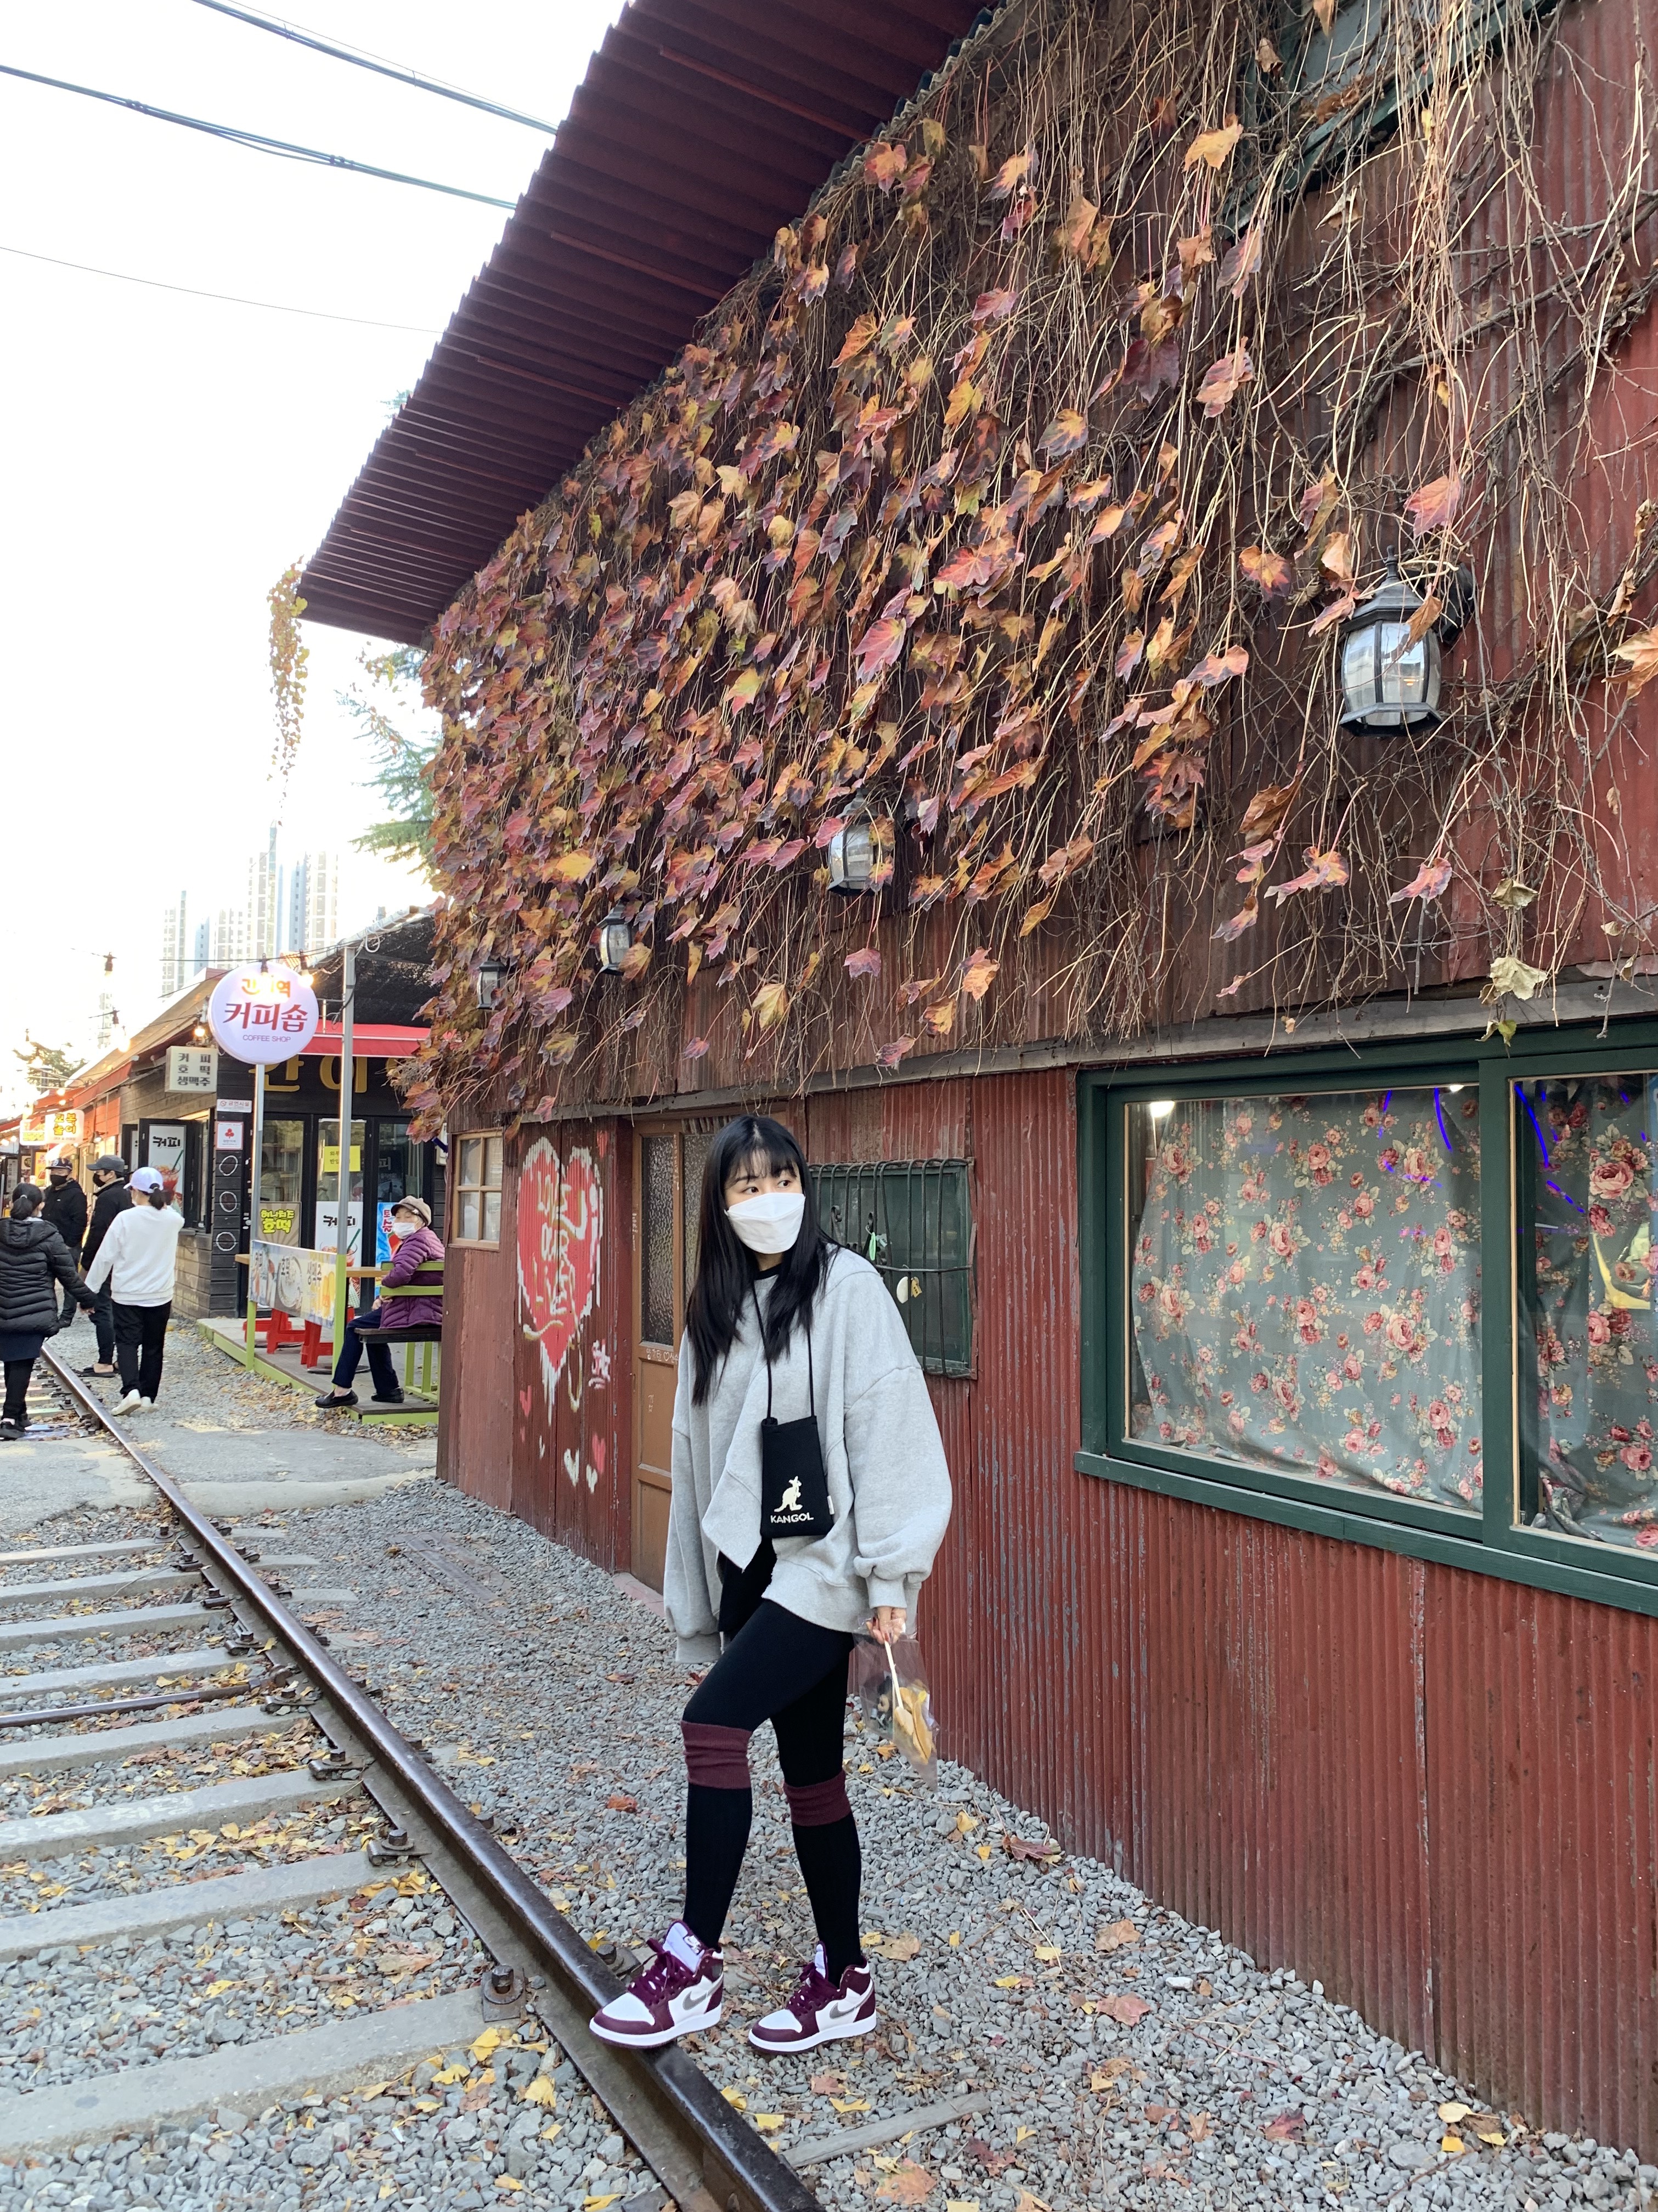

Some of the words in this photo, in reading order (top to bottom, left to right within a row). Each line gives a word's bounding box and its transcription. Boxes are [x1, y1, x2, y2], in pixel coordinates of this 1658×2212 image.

[241, 978, 291, 997] 간역
[223, 1002, 308, 1032] 커피숍
[177, 1076, 211, 1086] 생맥주
[53, 1113, 77, 1125] 교복
[53, 1124, 76, 1136] 놀이
[153, 1136, 181, 1147] 커피
[260, 1209, 295, 1219] 허니치즈
[262, 1218, 292, 1234] 호떡
[307, 1261, 322, 1288] 생맥주
[770, 1512, 814, 1523] KANGOL
